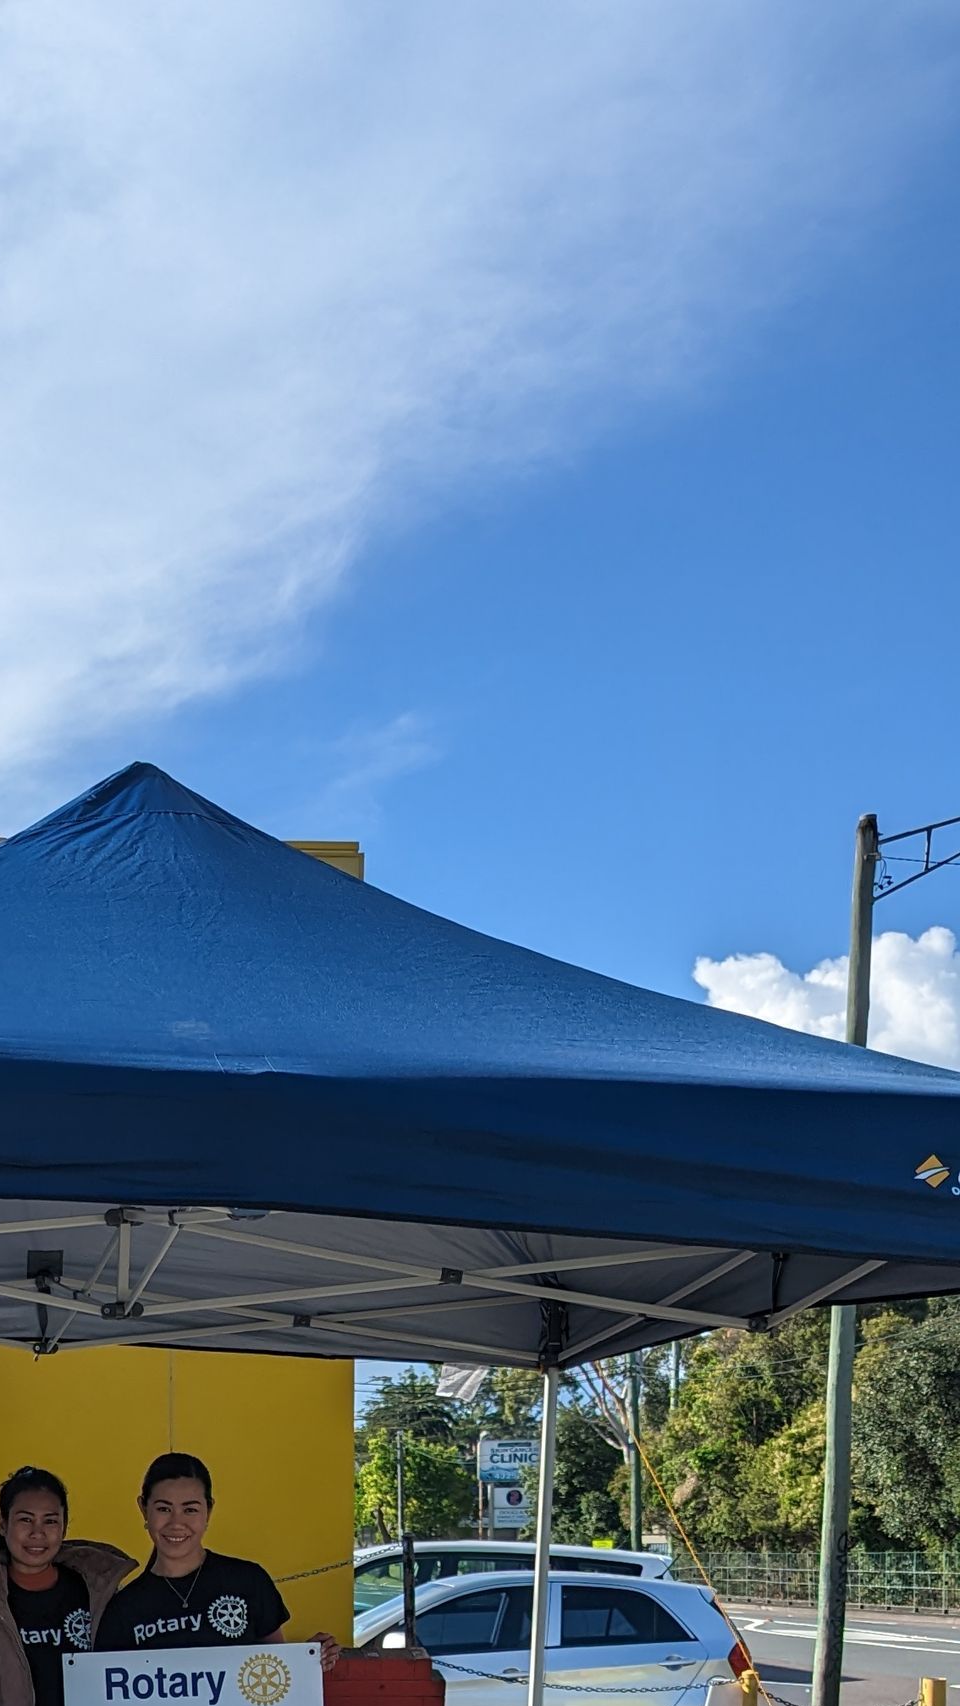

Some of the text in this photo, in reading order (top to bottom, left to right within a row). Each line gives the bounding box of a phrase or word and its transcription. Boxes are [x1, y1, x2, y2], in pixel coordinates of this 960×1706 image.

[489, 1453, 539, 1464] CLINIC
[133, 1612, 202, 1646] Rotary
[105, 1666, 227, 1706] Rotary
